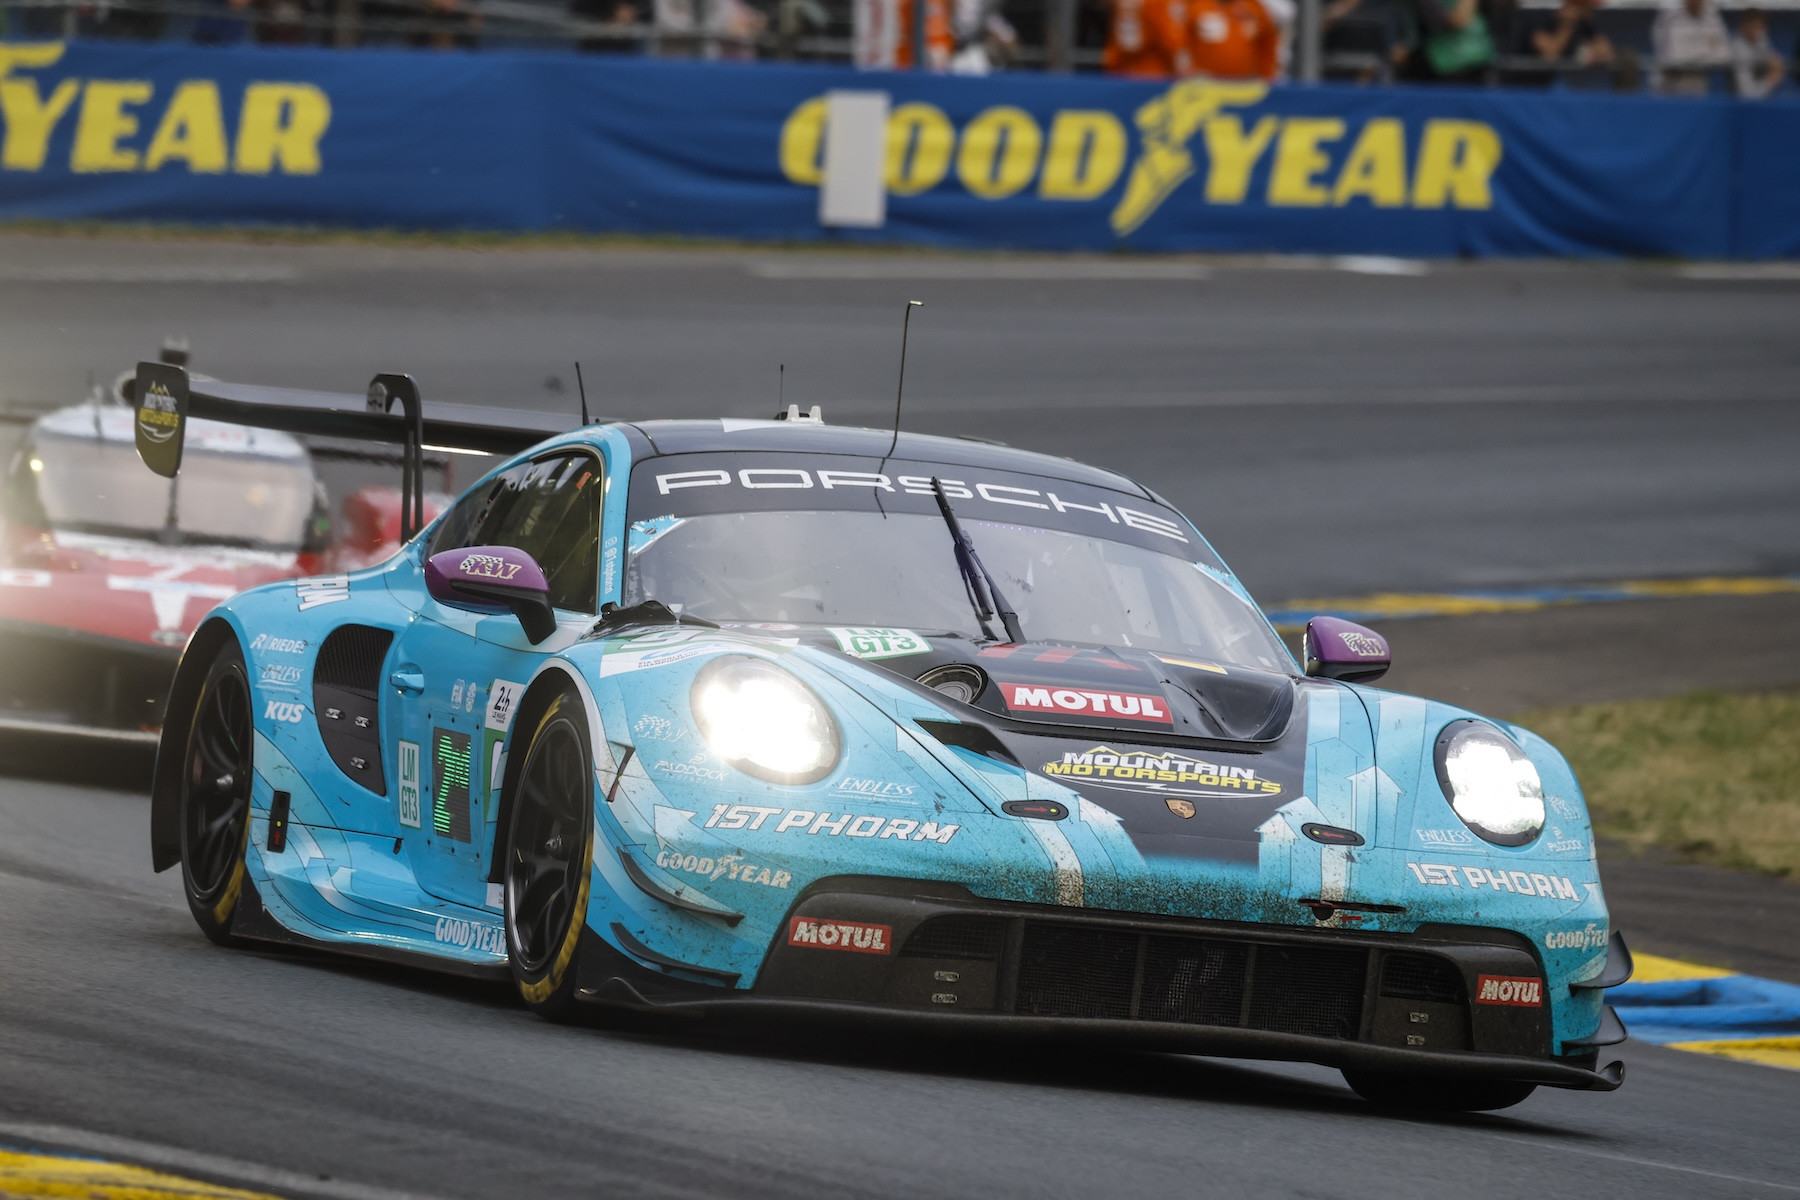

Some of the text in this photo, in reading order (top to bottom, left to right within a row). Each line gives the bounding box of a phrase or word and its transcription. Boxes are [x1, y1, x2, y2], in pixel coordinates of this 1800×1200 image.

[655, 468, 1189, 544] PORSCHE
[464, 557, 522, 579] KW
[844, 628, 900, 636] LM
[849, 635, 918, 654] GT3
[1013, 687, 1164, 718] MOTUL
[402, 746, 416, 783] LM
[1044, 762, 1282, 794] MOTORSPORTS
[1062, 752, 1255, 780] MOUNTAIN
[838, 776, 917, 797] ENDLESS
[401, 785, 418, 822] GT3
[704, 803, 961, 845] 1ST PHORM
[1416, 829, 1473, 843] ENDLESS
[656, 850, 792, 889] GOODYEAR
[1407, 862, 1581, 903] 1ST PHORM
[792, 921, 886, 950] MOTUL
[1545, 922, 1610, 953] GOODYEA
[1480, 979, 1541, 1003] MOTUL
